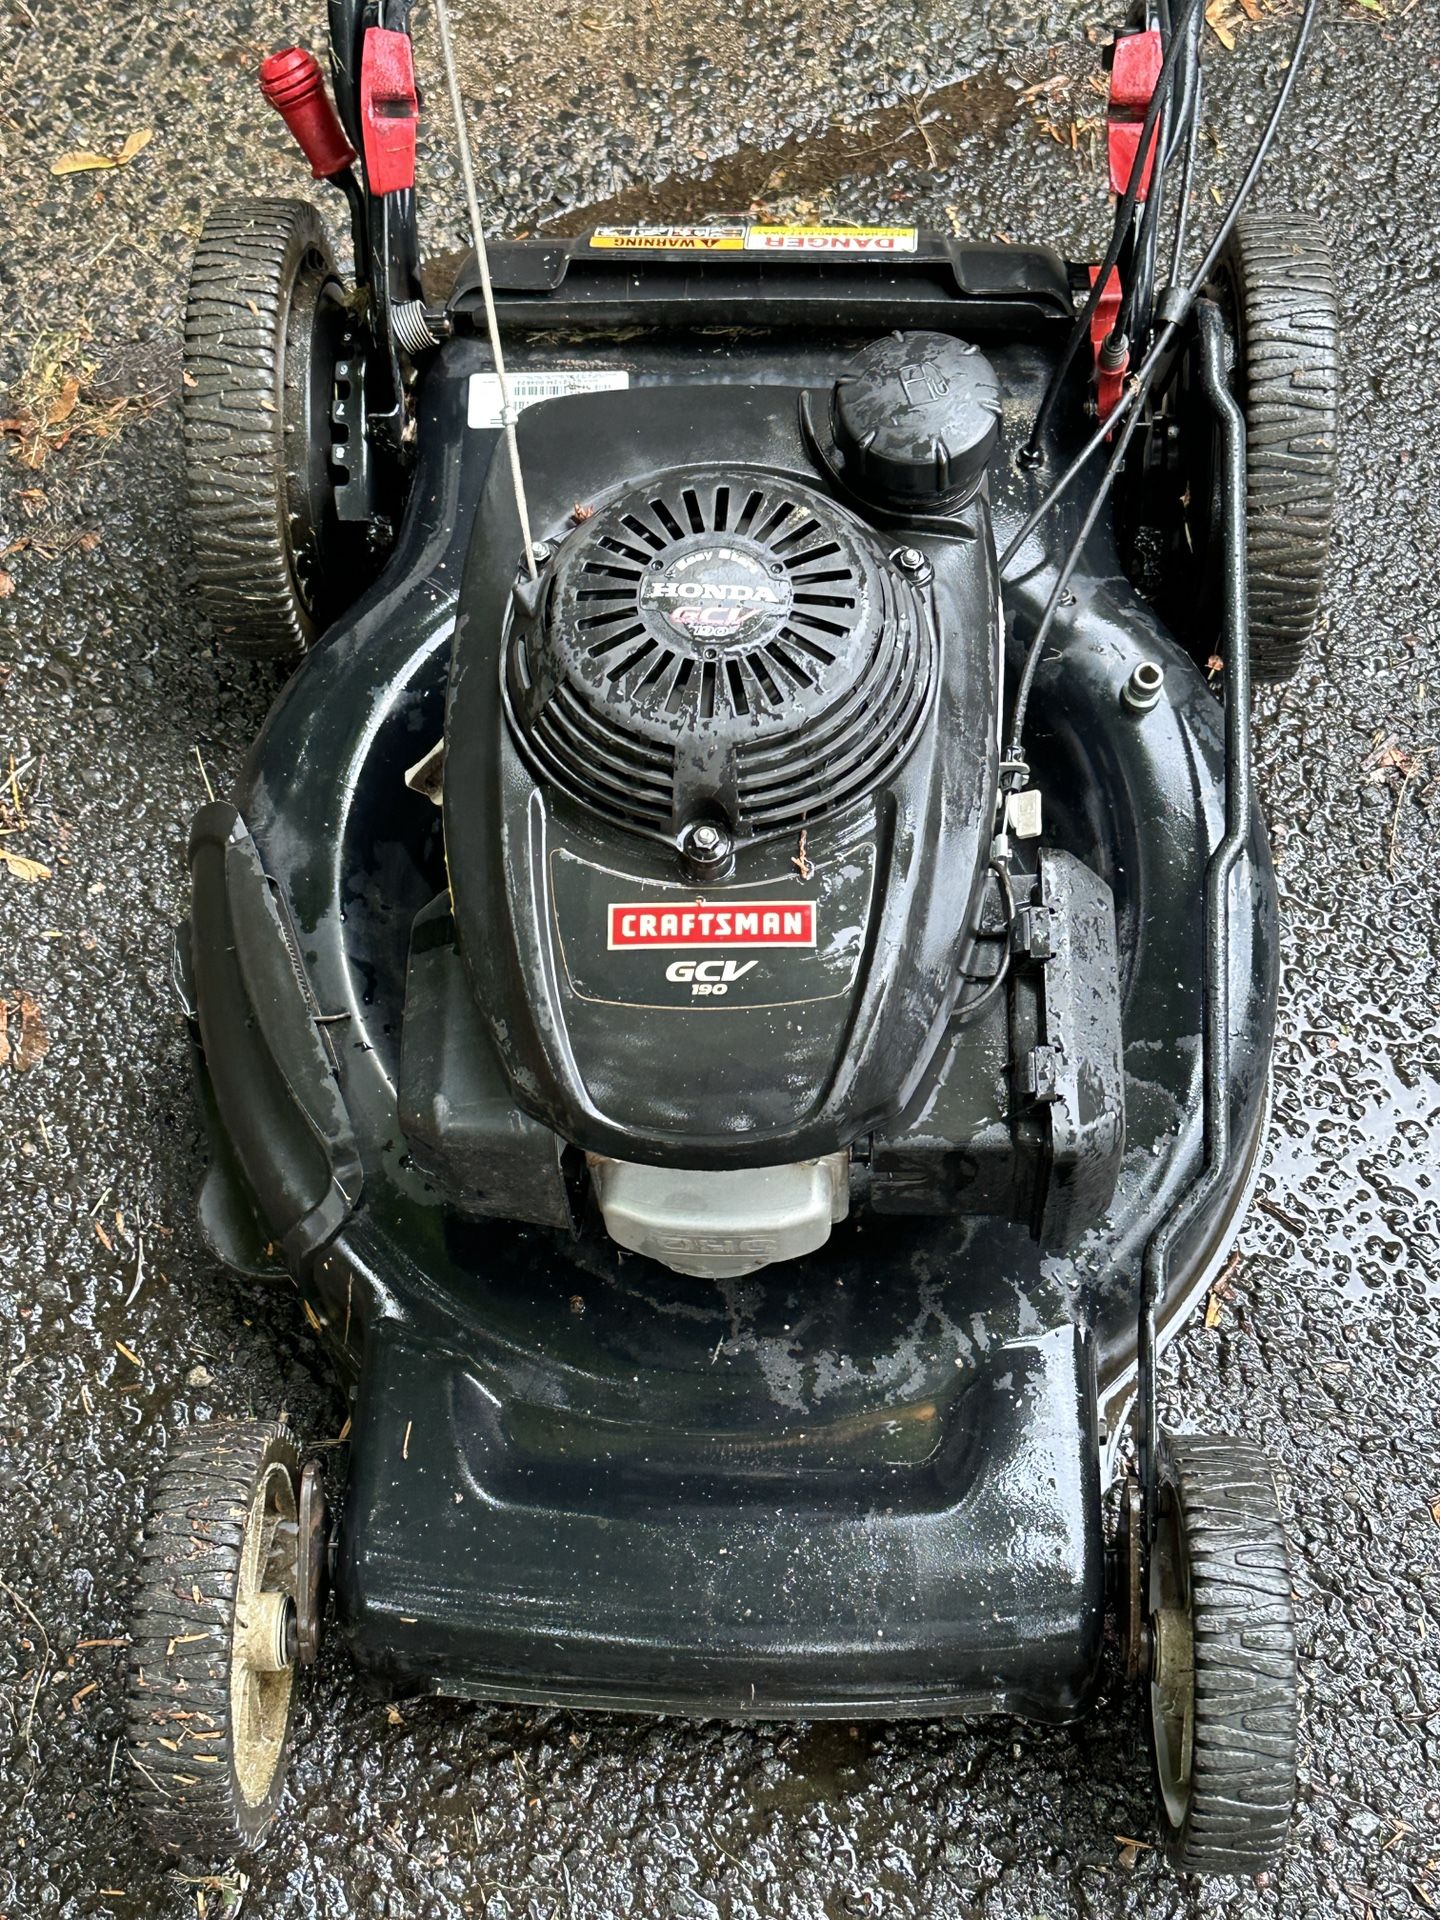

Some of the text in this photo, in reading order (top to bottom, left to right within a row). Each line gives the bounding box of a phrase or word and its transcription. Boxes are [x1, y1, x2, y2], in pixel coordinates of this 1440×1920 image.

[614, 238, 695, 247] WARNING
[764, 236, 895, 248] DANGER
[335, 403, 345, 415] 7
[335, 447, 345, 459] 8
[648, 582, 780, 603] HONDA
[670, 606, 763, 624] GCV
[621, 912, 802, 937] CRAFTSMAN
[665, 960, 759, 982] GCV
[691, 983, 728, 995] 190
